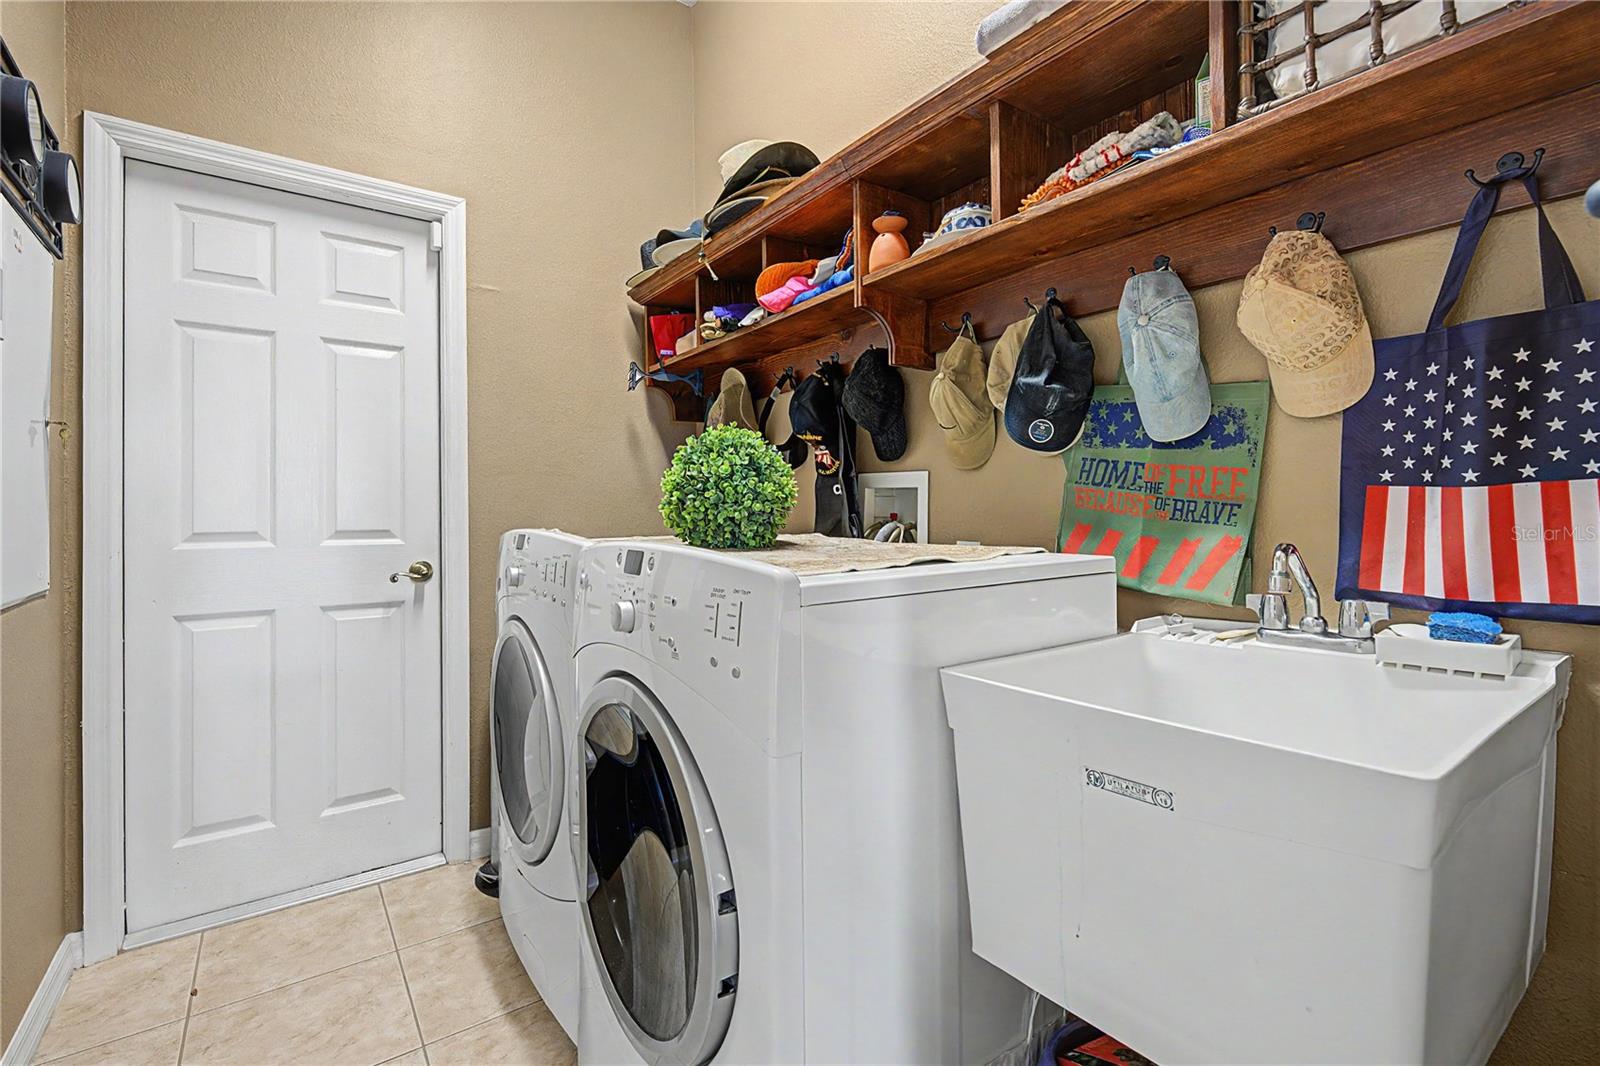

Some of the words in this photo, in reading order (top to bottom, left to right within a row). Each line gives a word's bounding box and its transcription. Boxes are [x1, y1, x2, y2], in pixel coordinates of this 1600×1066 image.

[1074, 457, 1146, 492] HOME
[1144, 480, 1165, 495] THE
[1167, 463, 1249, 502] FREE
[1073, 487, 1156, 519] BECAUSE
[1154, 496, 1171, 512] OF
[1169, 498, 1243, 527] BRAVE
